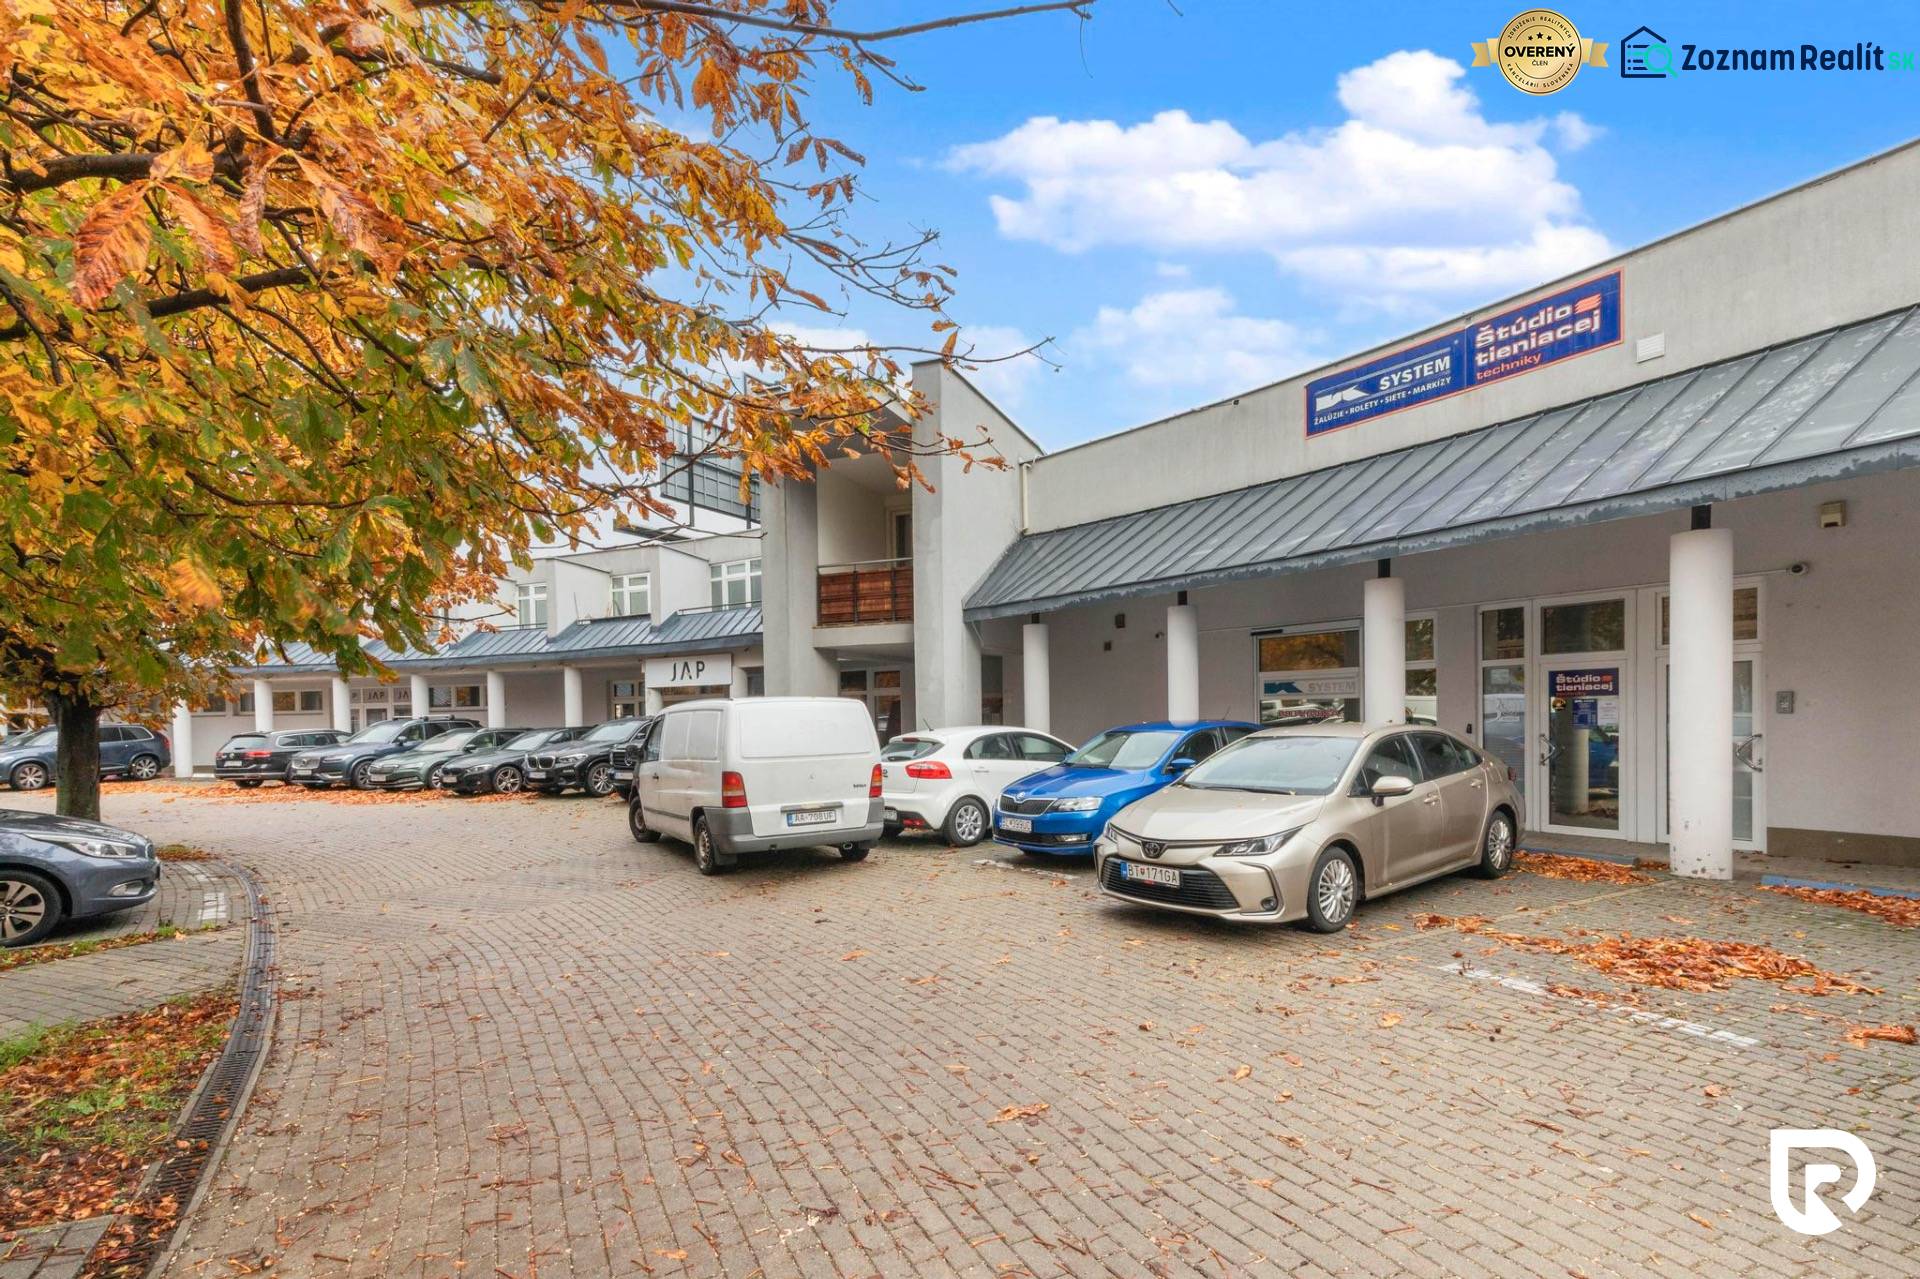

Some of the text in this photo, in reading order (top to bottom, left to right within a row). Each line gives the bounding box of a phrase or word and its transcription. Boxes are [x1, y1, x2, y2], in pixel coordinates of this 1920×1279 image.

[1475, 304, 1573, 348] Štúdio
[1475, 309, 1600, 366] tieniacej
[1379, 355, 1451, 391] SYSTEM
[1476, 353, 1542, 380] techniky
[1314, 376, 1452, 425] ŽALÚZIE ROLETY SIETE MARKÍZY
[670, 661, 706, 682] JAP
[1556, 673, 1601, 683] Štúdio
[1556, 682, 1613, 691] tieniacej
